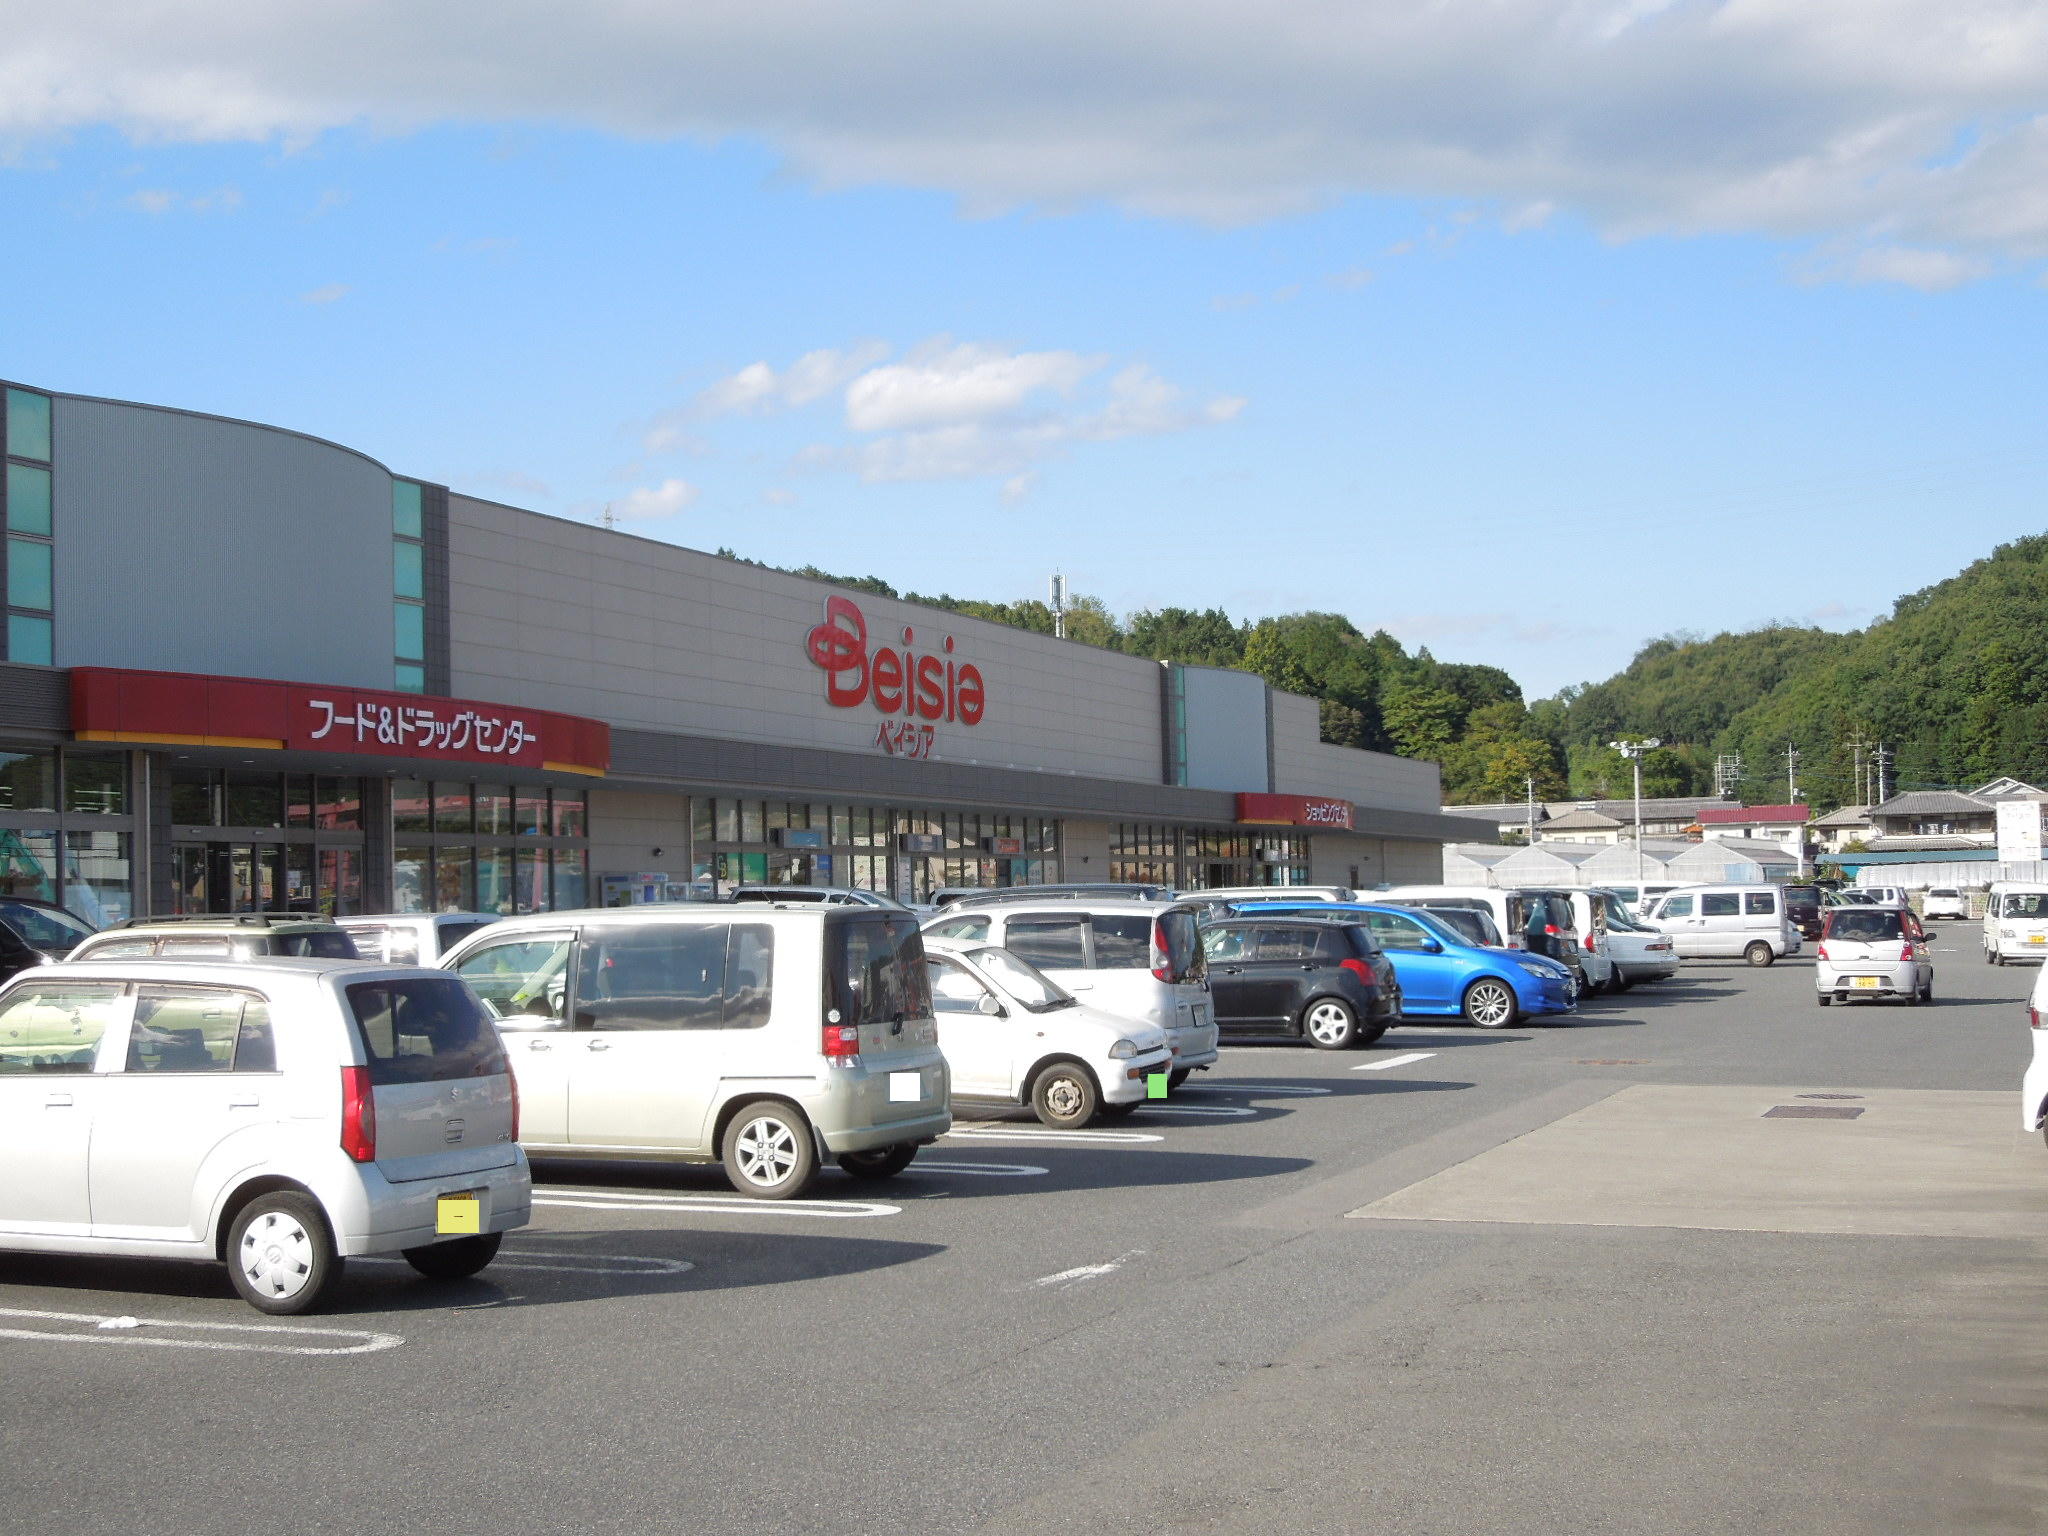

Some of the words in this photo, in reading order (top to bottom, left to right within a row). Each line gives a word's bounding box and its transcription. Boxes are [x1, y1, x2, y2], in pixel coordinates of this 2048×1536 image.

[807, 594, 986, 726] Beisia
[310, 699, 537, 756] フード&ドラッグセンター
[874, 720, 936, 760] ベイシア
